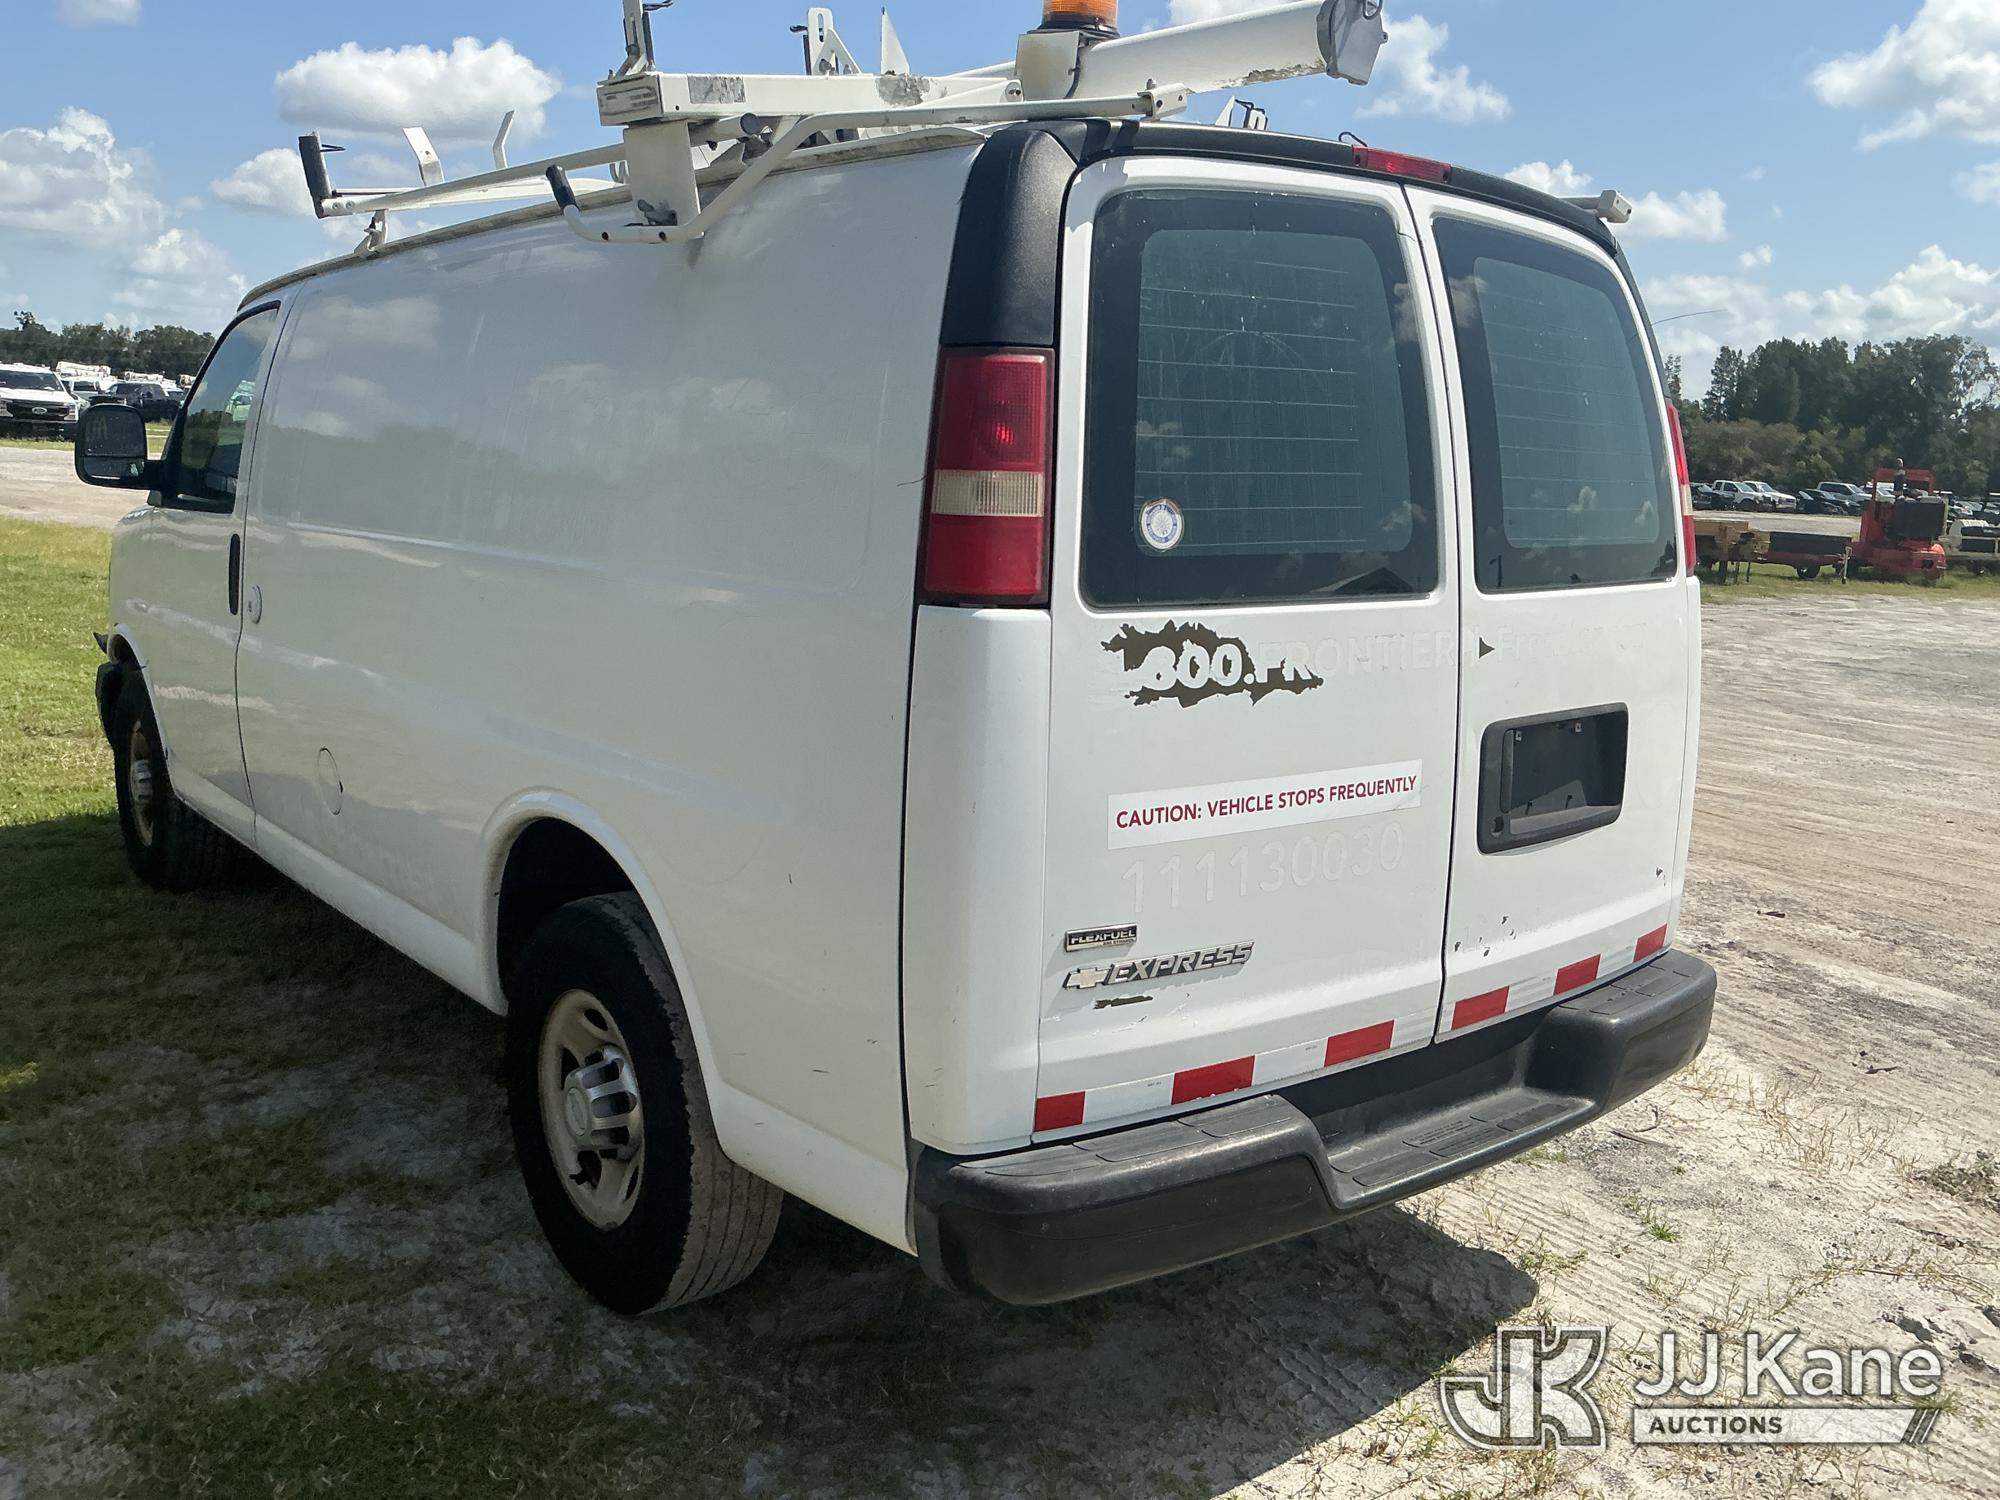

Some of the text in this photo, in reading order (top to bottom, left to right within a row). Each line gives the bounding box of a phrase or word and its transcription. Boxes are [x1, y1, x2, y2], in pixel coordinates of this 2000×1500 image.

[1116, 775, 1416, 829] CAUTION: VEHICLE STOPS FREQUENTLY
[1108, 942, 1254, 984] EXPRESS
